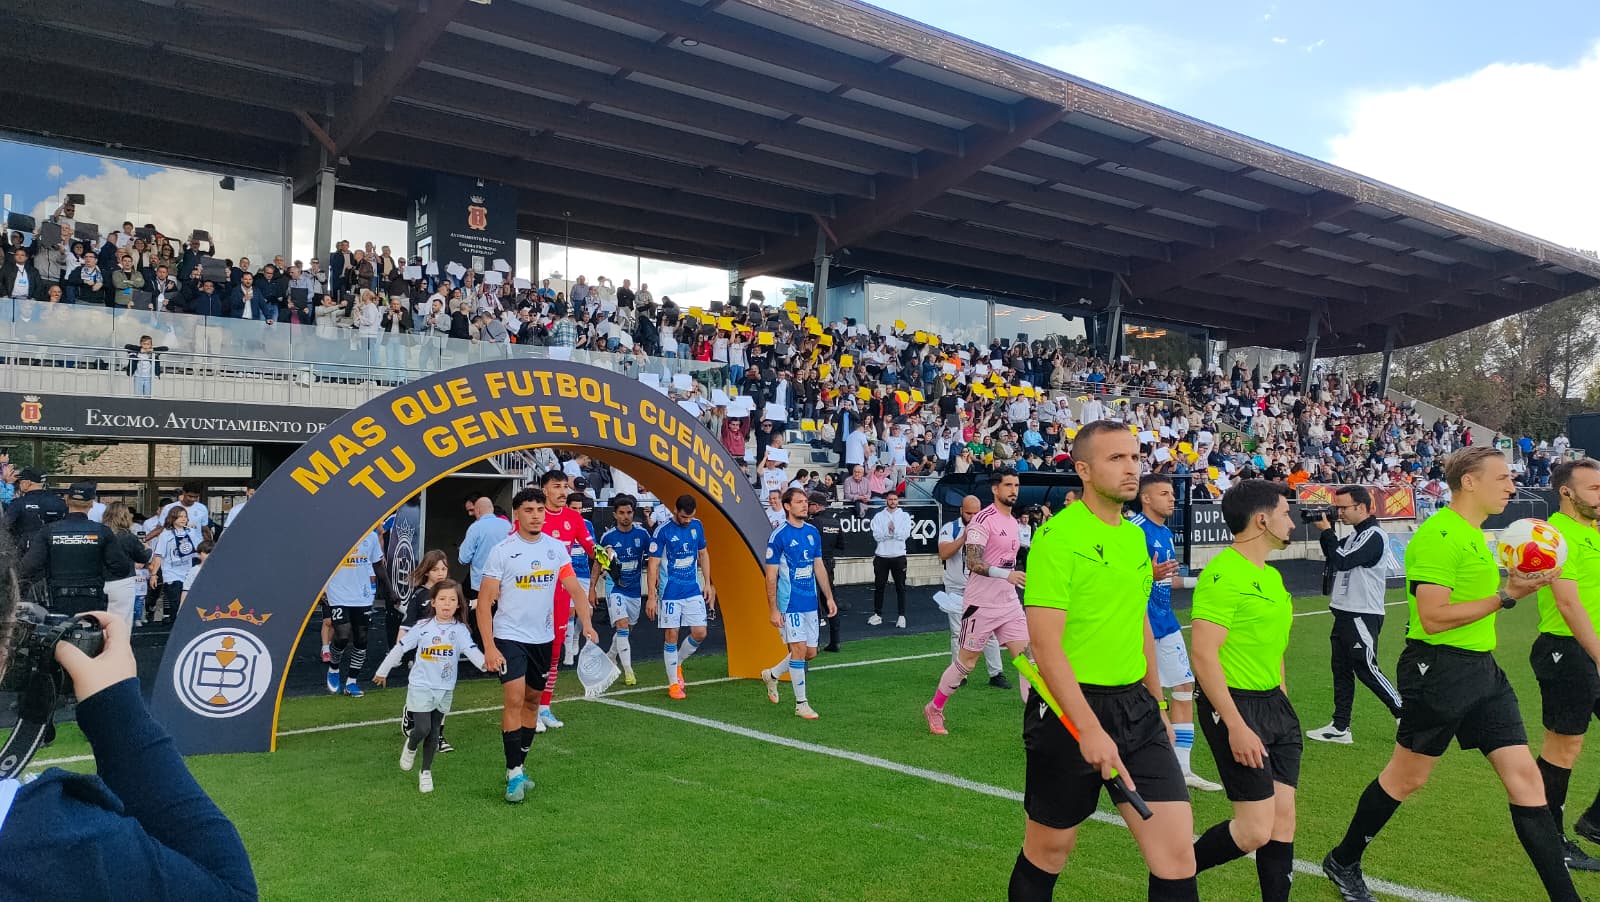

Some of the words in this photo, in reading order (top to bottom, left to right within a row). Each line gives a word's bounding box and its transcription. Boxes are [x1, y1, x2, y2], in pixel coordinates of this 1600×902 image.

[85, 408, 160, 428] EXCMO.
[164, 411, 302, 433] AYUNTAMIENTO
[289, 416, 387, 495] MAS
[391, 377, 478, 426] QUE
[484, 370, 628, 415] FUTBOL,
[639, 399, 741, 504] CUENCA,
[348, 445, 416, 499] TU
[422, 405, 580, 458] GENTE,
[589, 411, 637, 447] TU
[649, 434, 724, 504] CLUB
[1195, 511, 1226, 523] DUPL
[515, 573, 554, 584] VIALES
[616, 595, 622, 607] 3
[332, 607, 343, 620] 22
[665, 601, 675, 615] 16
[788, 613, 801, 627] 18
[421, 647, 454, 656] VIALES
